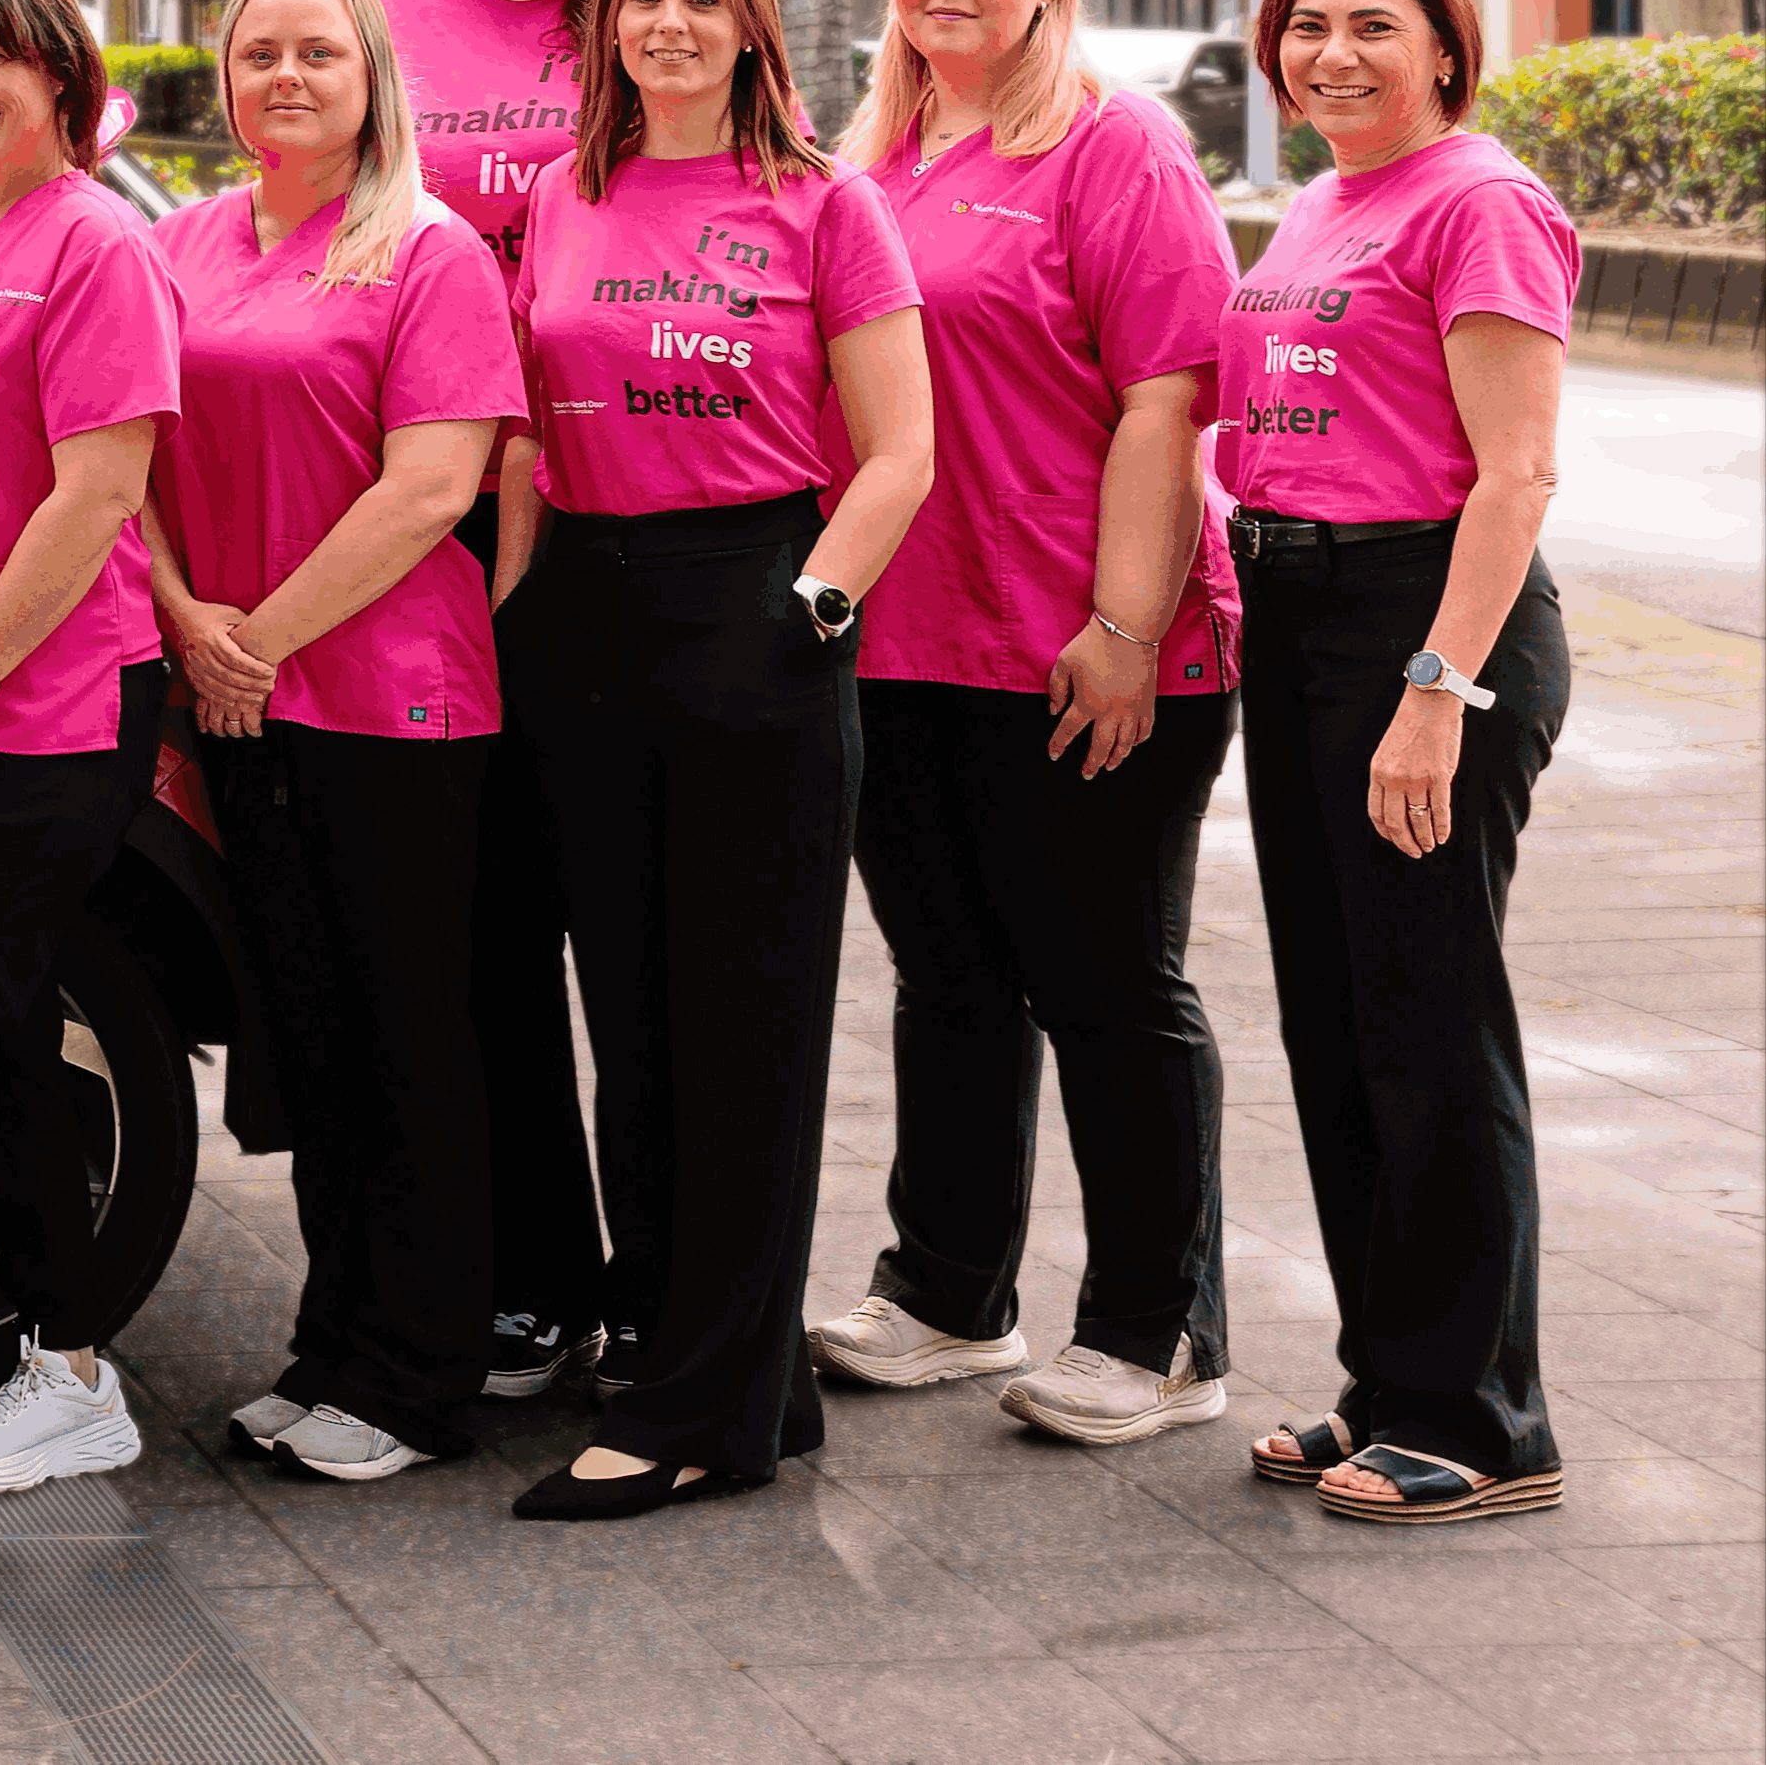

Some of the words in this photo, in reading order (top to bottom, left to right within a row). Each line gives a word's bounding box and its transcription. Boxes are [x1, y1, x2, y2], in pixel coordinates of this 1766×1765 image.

[539, 53, 583, 83] i'
[479, 151, 539, 194] liv
[696, 225, 770, 271] i'm
[593, 270, 759, 319] making
[1231, 282, 1352, 323] making
[650, 320, 754, 369] lives
[1264, 334, 1338, 376] lives
[623, 379, 751, 420] better
